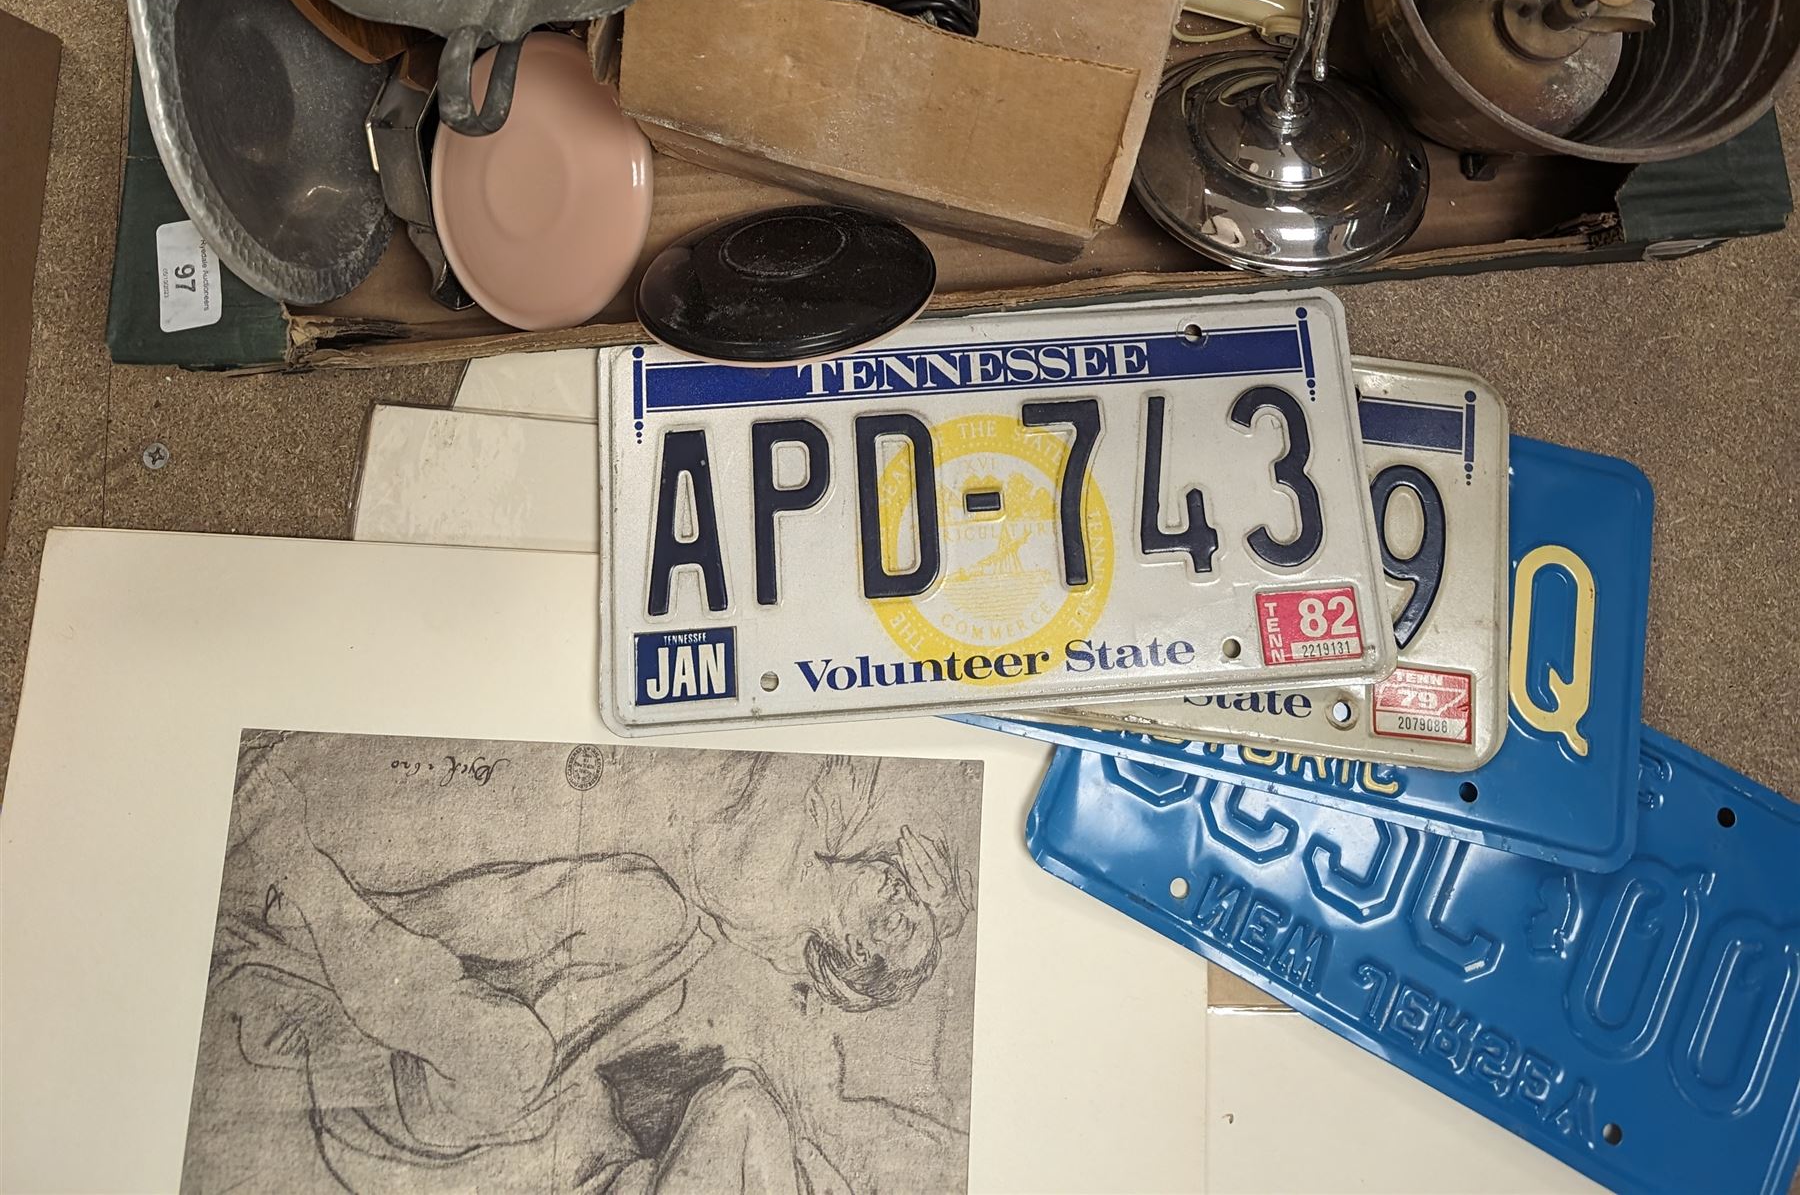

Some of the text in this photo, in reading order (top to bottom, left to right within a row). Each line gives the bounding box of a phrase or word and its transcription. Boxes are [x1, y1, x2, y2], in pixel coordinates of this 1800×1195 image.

[174, 263, 197, 293] 97
[797, 341, 1150, 395] TENNESSEE
[648, 386, 1324, 615] APD-743
[663, 632, 707, 646] TENNESSEE
[1264, 602, 1287, 664] TENN
[1298, 595, 1357, 638] 82
[646, 642, 726, 700] JAN
[795, 639, 1196, 693] Volunteer State
[1301, 640, 1351, 658] 2219131
[1509, 544, 1596, 758] Q
[1394, 671, 1444, 686] TENN
[1397, 688, 1438, 710] 79
